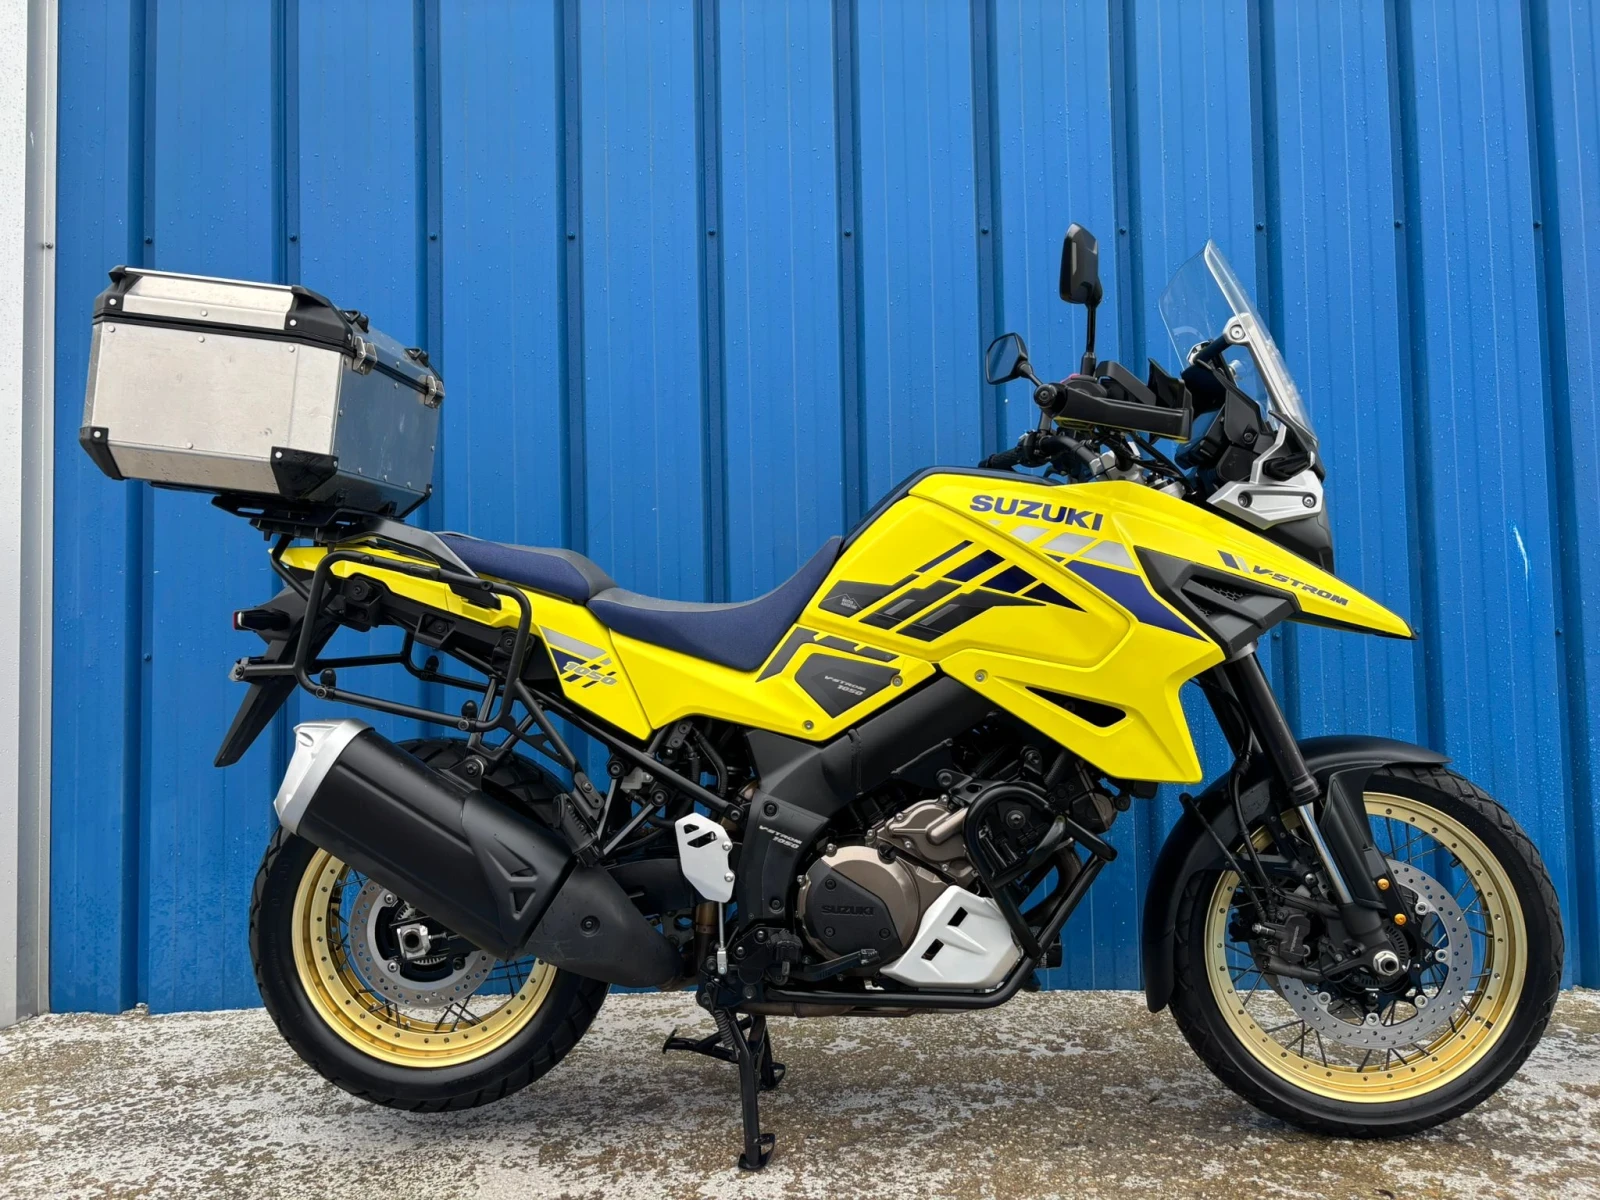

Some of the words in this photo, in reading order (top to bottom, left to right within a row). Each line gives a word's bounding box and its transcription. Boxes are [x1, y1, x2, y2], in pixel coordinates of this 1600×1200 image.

[969, 494, 1104, 532] SUZUKI
[1253, 565, 1349, 606] V-STROM
[563, 661, 618, 686] 1050
[824, 675, 867, 692] V-STROM
[837, 684, 864, 696] 1050
[759, 824, 803, 845] V-STROM
[772, 836, 800, 849] 1050
[820, 904, 876, 917] SUZUKI
